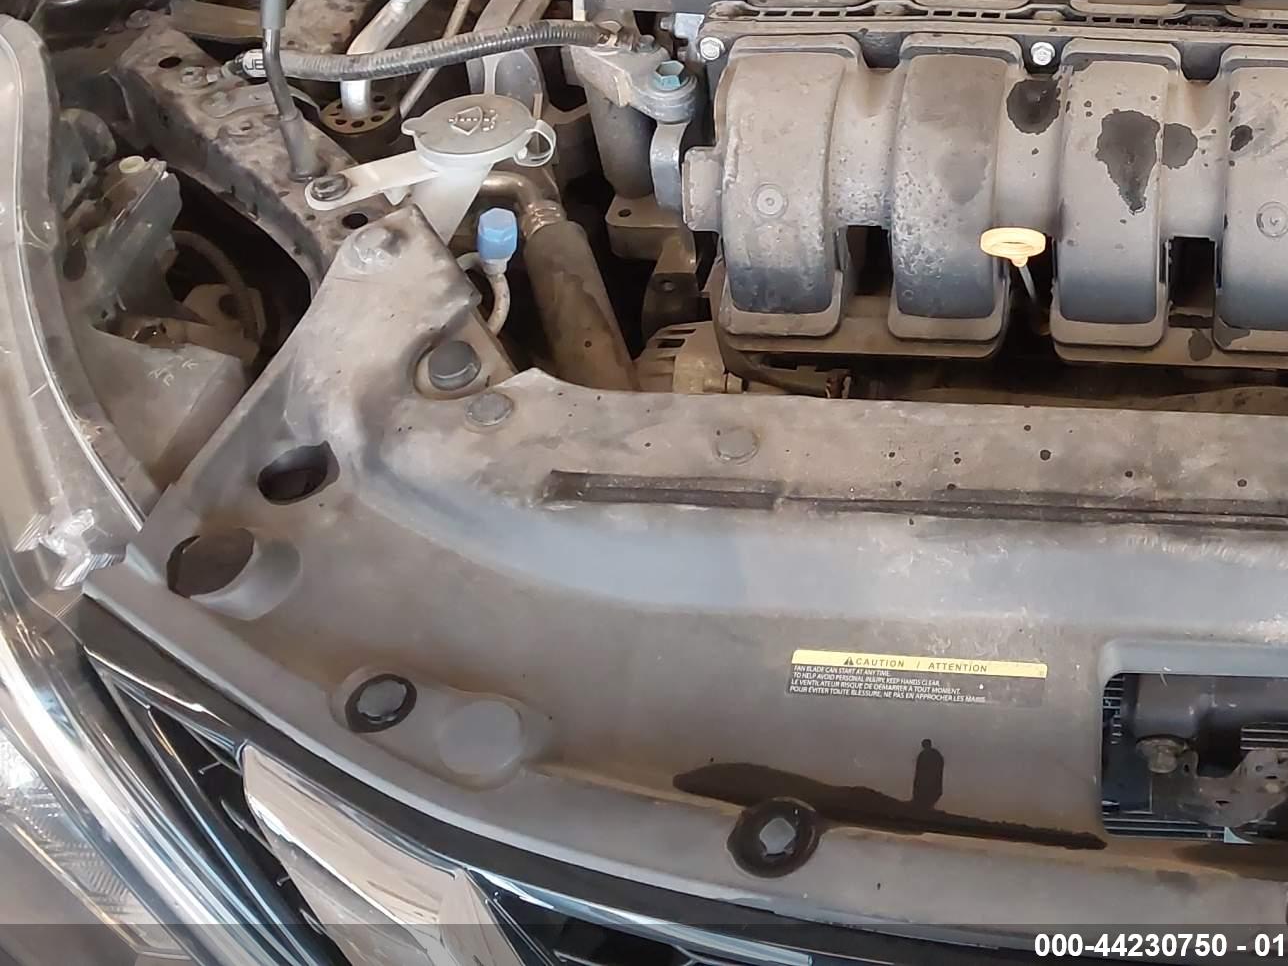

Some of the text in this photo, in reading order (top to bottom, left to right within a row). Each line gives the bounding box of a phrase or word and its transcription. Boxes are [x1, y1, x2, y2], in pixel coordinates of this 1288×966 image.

[856, 658, 904, 668] CAUTION
[928, 664, 987, 672] ATTENTION
[799, 679, 840, 687] VENTILATEUR
[840, 681, 863, 689] RISQUE
[836, 674, 865, 682] PERSONAL
[790, 685, 807, 693] POUR
[829, 687, 850, 695] TOUTE
[893, 691, 904, 699] PAS
[915, 693, 953, 701] APPROCHER
